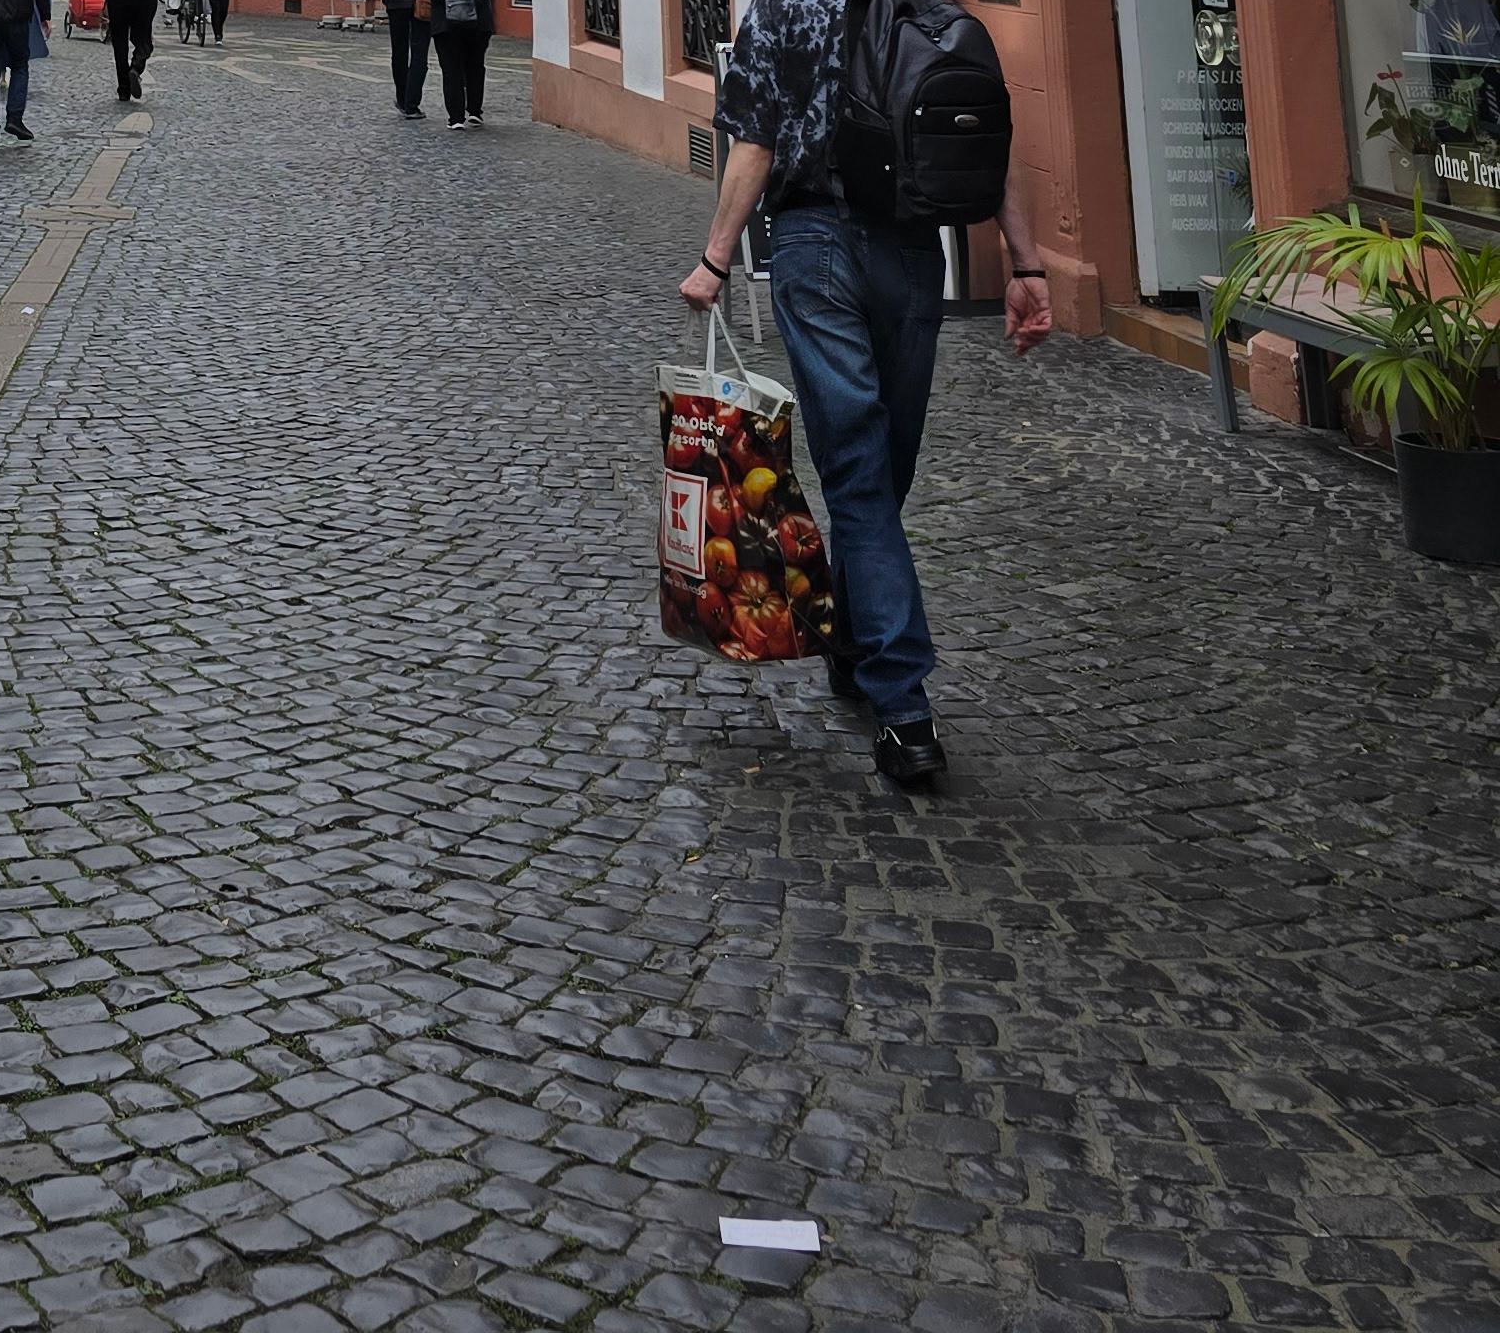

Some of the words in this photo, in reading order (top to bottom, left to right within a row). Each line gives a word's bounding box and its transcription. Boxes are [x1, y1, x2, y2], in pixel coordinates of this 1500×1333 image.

[1165, 145, 1194, 159] KINDER
[1434, 143, 1469, 183] ohne
[1167, 169, 1187, 183] BART
[1188, 170, 1214, 183] RASUR
[1188, 193, 1208, 207] WAX
